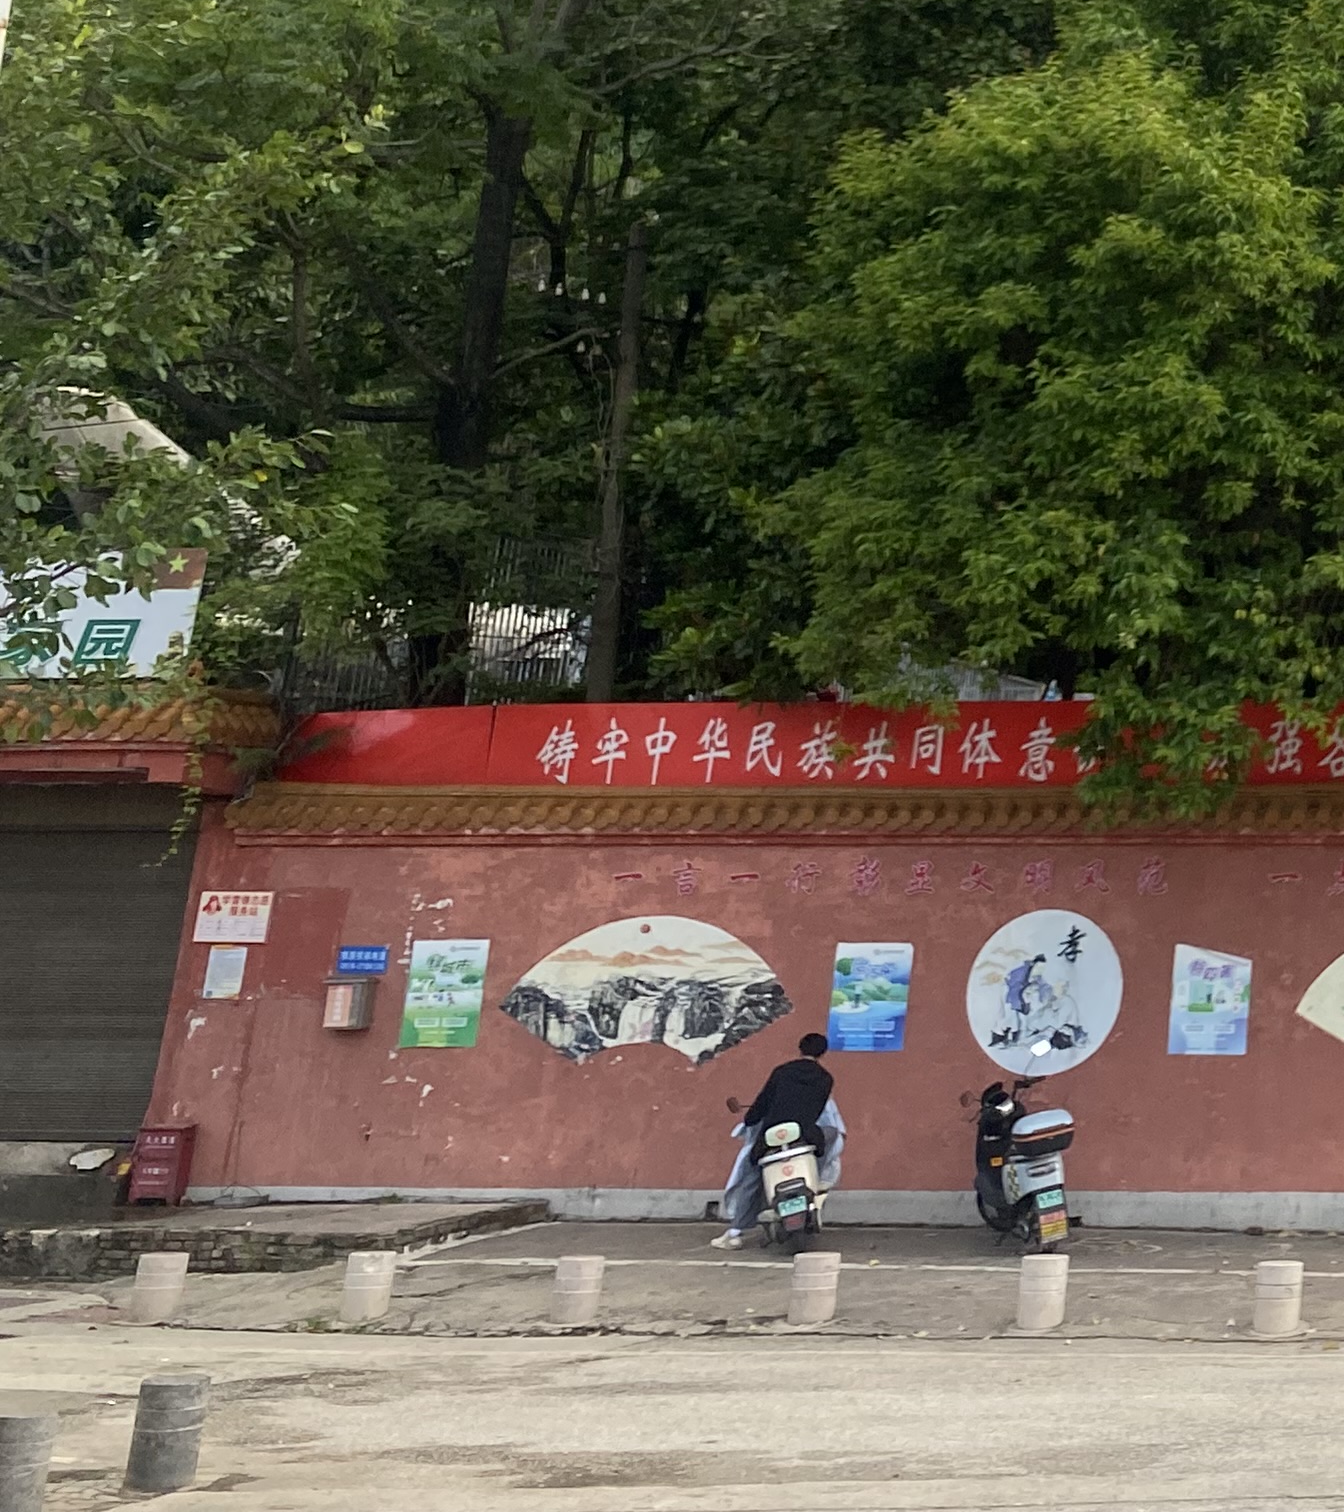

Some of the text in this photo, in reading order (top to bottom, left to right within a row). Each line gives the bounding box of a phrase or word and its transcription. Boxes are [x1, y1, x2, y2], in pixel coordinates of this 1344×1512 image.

[536, 716, 1100, 785] 铸牢中华民族共同体意
[1057, 925, 1087, 964] 孝
